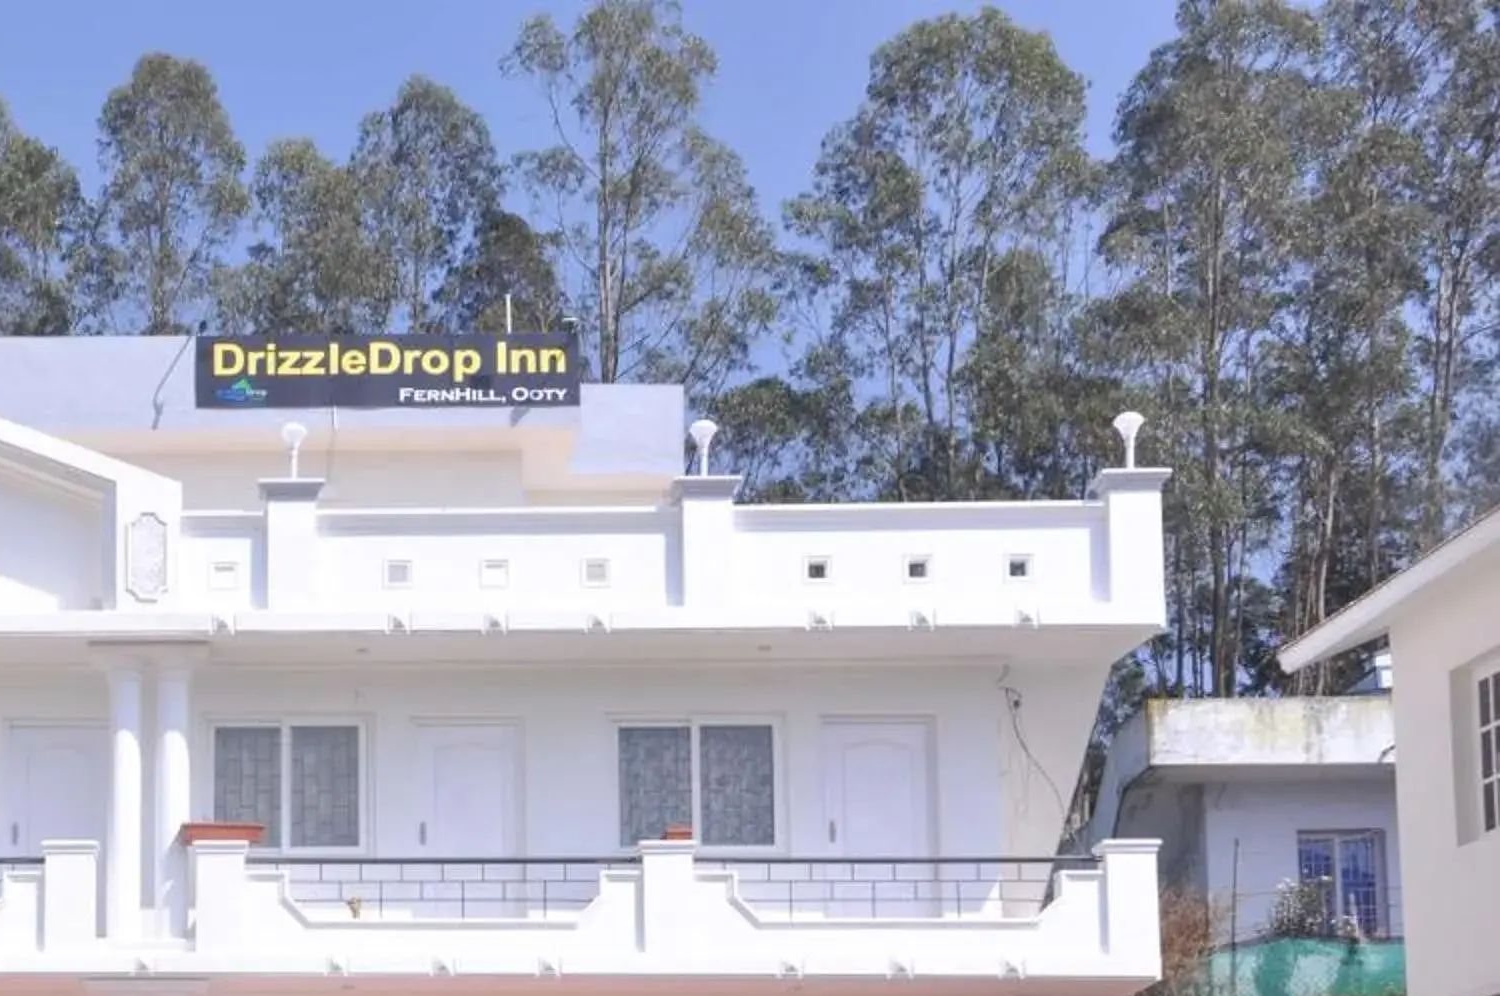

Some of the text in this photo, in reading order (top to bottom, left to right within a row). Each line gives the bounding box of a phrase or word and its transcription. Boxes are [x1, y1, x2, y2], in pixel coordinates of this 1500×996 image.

[212, 342, 566, 382] DrizzleDrop Inn
[512, 387, 567, 401] OOTY
